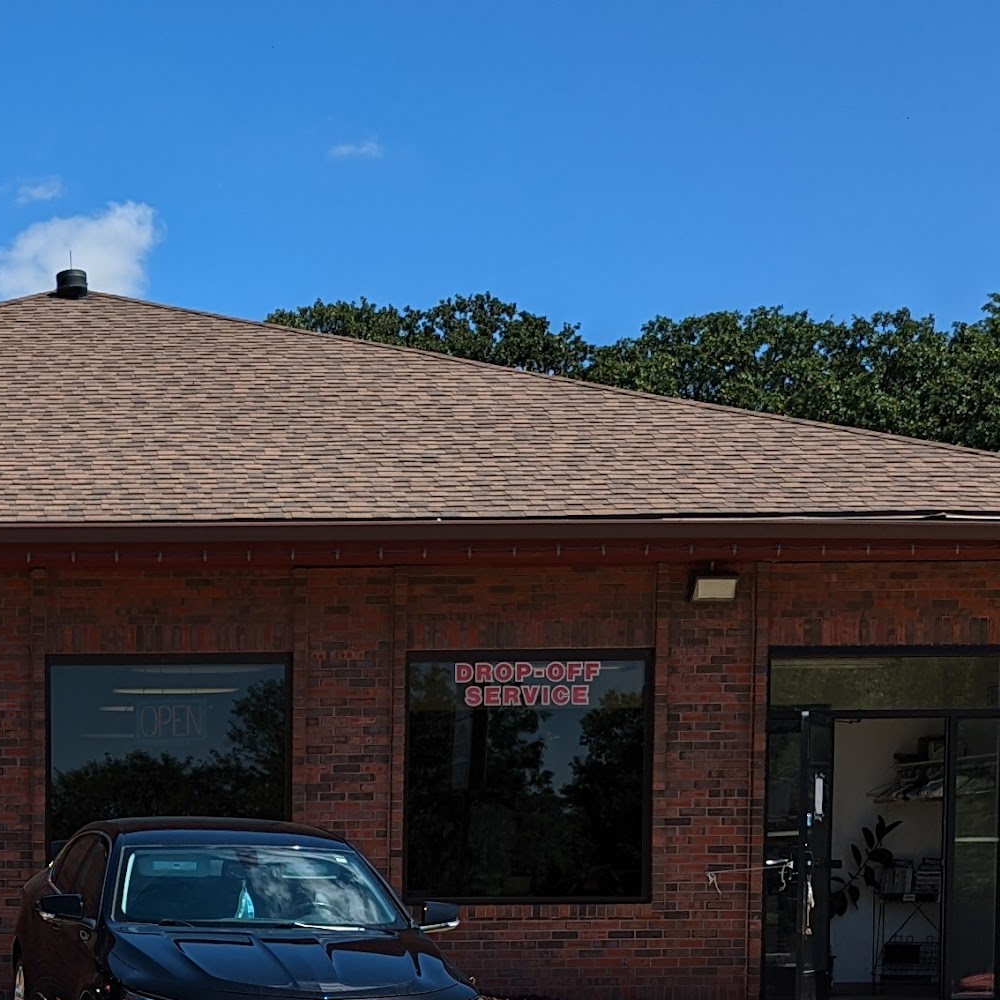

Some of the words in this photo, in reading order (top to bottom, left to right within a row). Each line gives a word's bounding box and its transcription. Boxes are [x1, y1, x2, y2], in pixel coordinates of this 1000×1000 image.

[455, 661, 601, 683] DROP-OFF
[464, 685, 590, 707] SERVICE
[140, 704, 203, 737] OPEN
